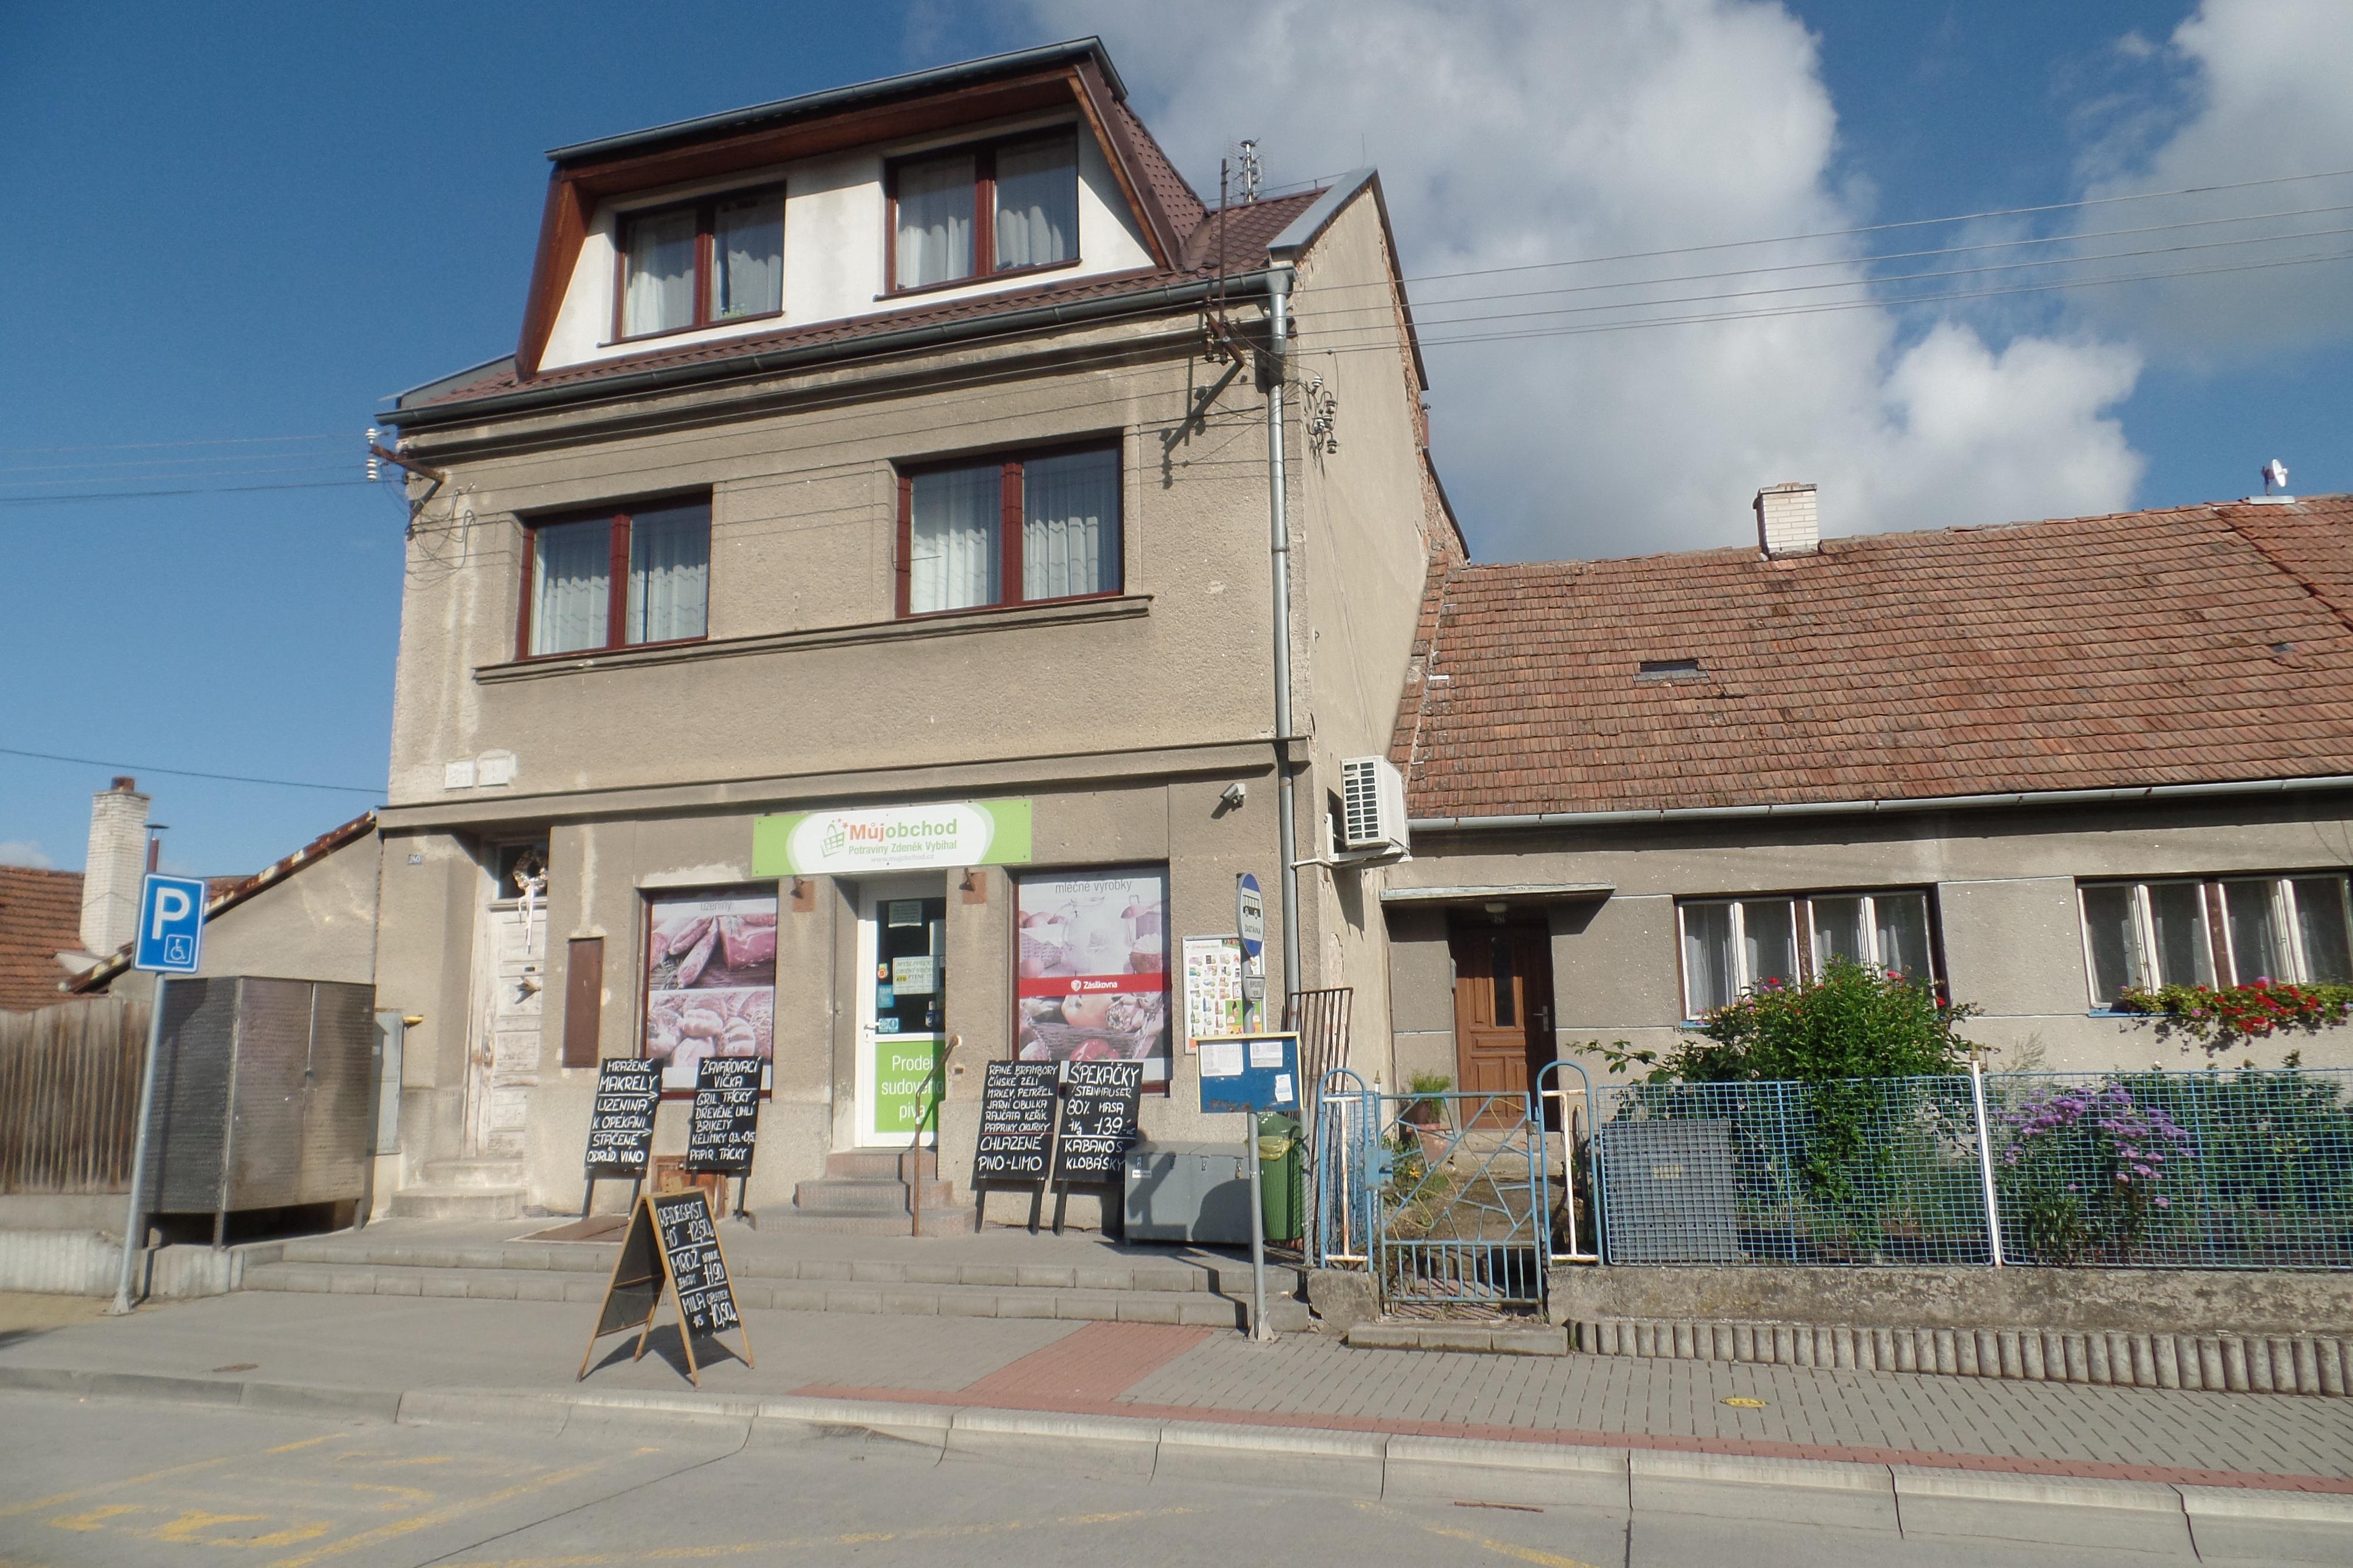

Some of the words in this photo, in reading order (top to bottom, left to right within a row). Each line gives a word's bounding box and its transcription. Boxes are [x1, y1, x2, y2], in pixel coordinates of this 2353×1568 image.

[849, 844, 888, 855] Potraviny
[891, 842, 922, 853] Zdeněk
[871, 854, 934, 863] www.mujobchod.cz
[152, 887, 190, 940] P
[1084, 981, 1118, 989] Zásilkovna
[606, 1058, 654, 1072] MRAŽENÉ
[1014, 1065, 1058, 1076] BRAMBORY
[1068, 1061, 1139, 1087] ŠPEKÁČKY
[599, 1075, 658, 1092] MAKRELY
[1018, 1086, 1054, 1097] PETRŽEL
[598, 1099, 647, 1112] UZENINA
[735, 1100, 755, 1117] UHLÍ
[986, 1097, 1011, 1110] JARNÍ
[1012, 1100, 1047, 1110] CIBULKA
[1099, 1102, 1124, 1115] MASA
[985, 1109, 1021, 1121] RAJČATA
[592, 1117, 599, 1129] K
[695, 1119, 732, 1133] BRIKETY
[1019, 1122, 1051, 1132] OKURKY
[980, 1133, 1044, 1151] CHLAZENÉ
[1064, 1139, 1124, 1153] KABANOS
[621, 1146, 644, 1163] VÍNO
[1066, 1154, 1126, 1171] KLOBÁSKY
[658, 1200, 702, 1228] RADEGAST
[670, 1247, 700, 1276] MROŽ
